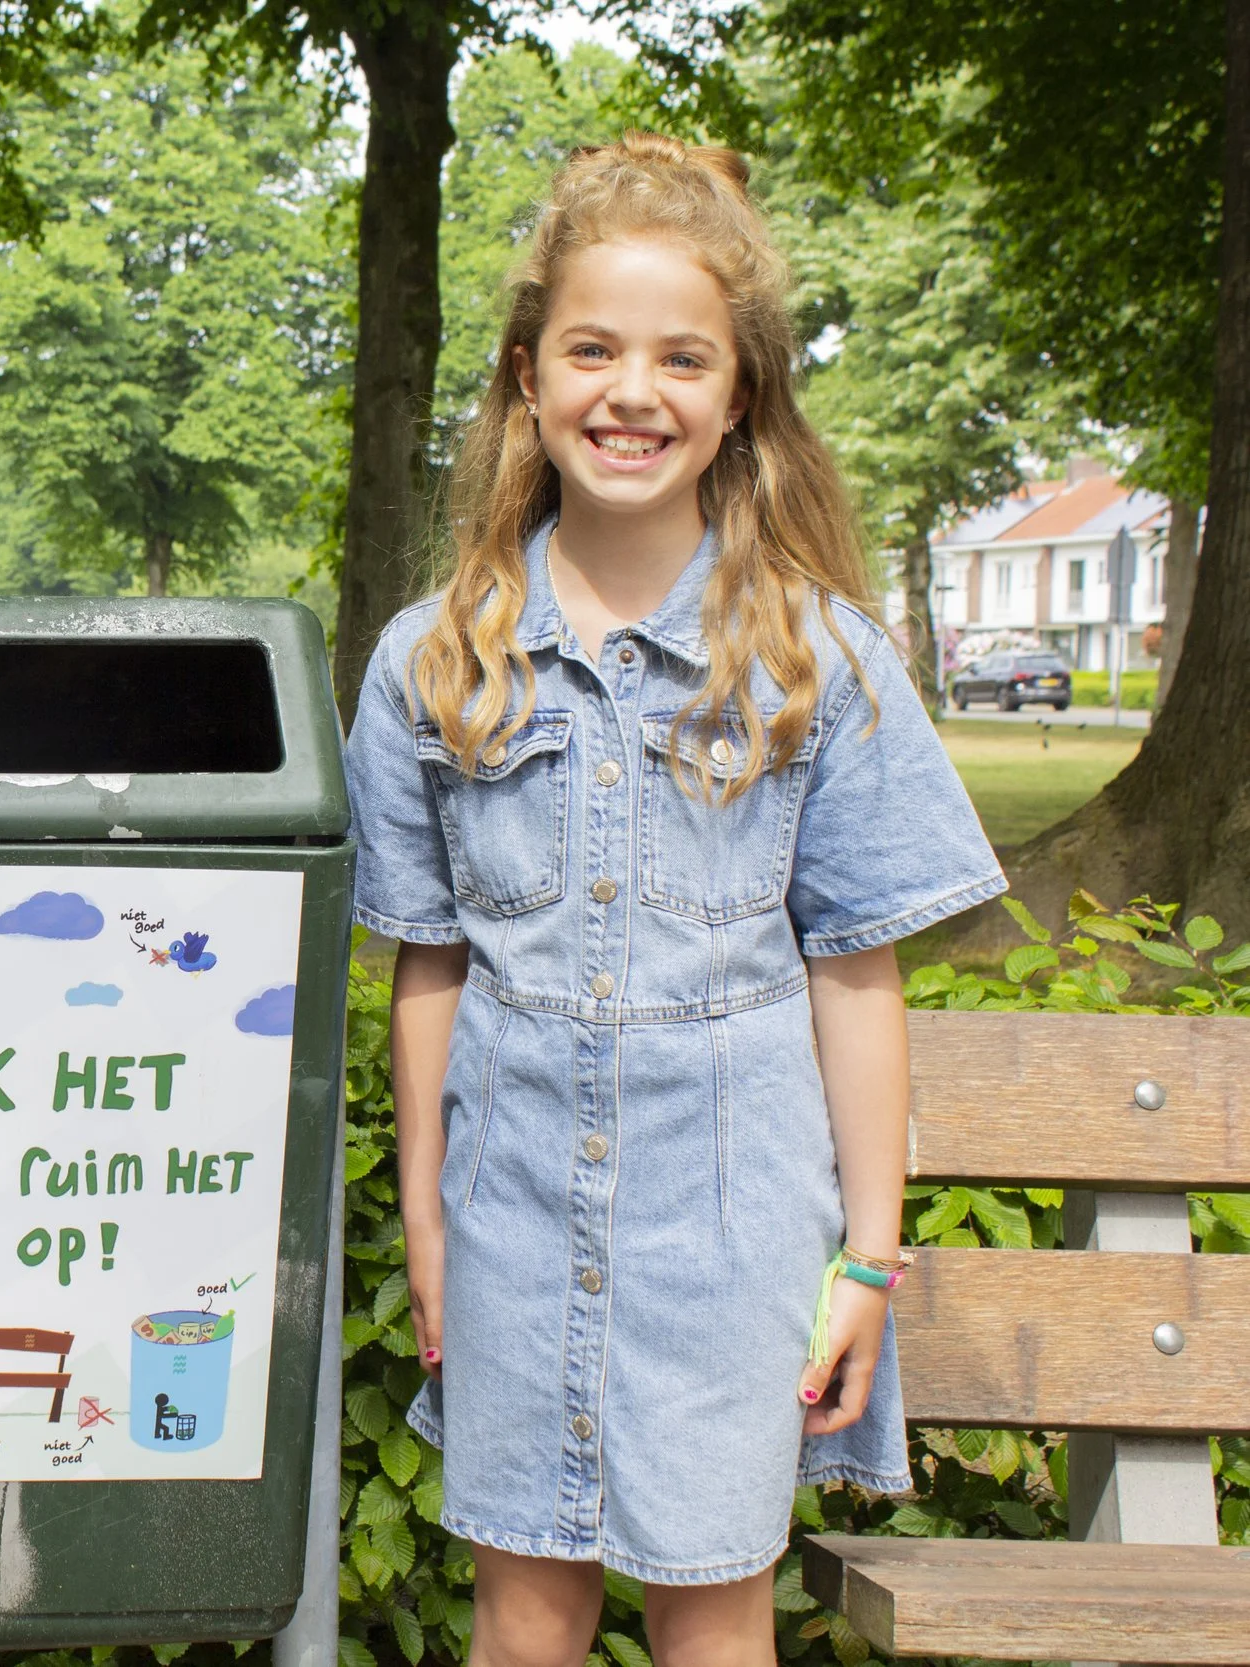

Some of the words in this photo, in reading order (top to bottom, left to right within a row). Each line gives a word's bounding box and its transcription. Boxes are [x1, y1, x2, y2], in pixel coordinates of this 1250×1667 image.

[120, 908, 147, 921] niet
[134, 918, 165, 934] goed
[52, 1051, 186, 1112] HET
[19, 1146, 143, 1197] ruim
[166, 1147, 254, 1195] HET
[197, 1282, 228, 1297] goed
[44, 1439, 71, 1451] niet
[52, 1453, 83, 1467] goed
